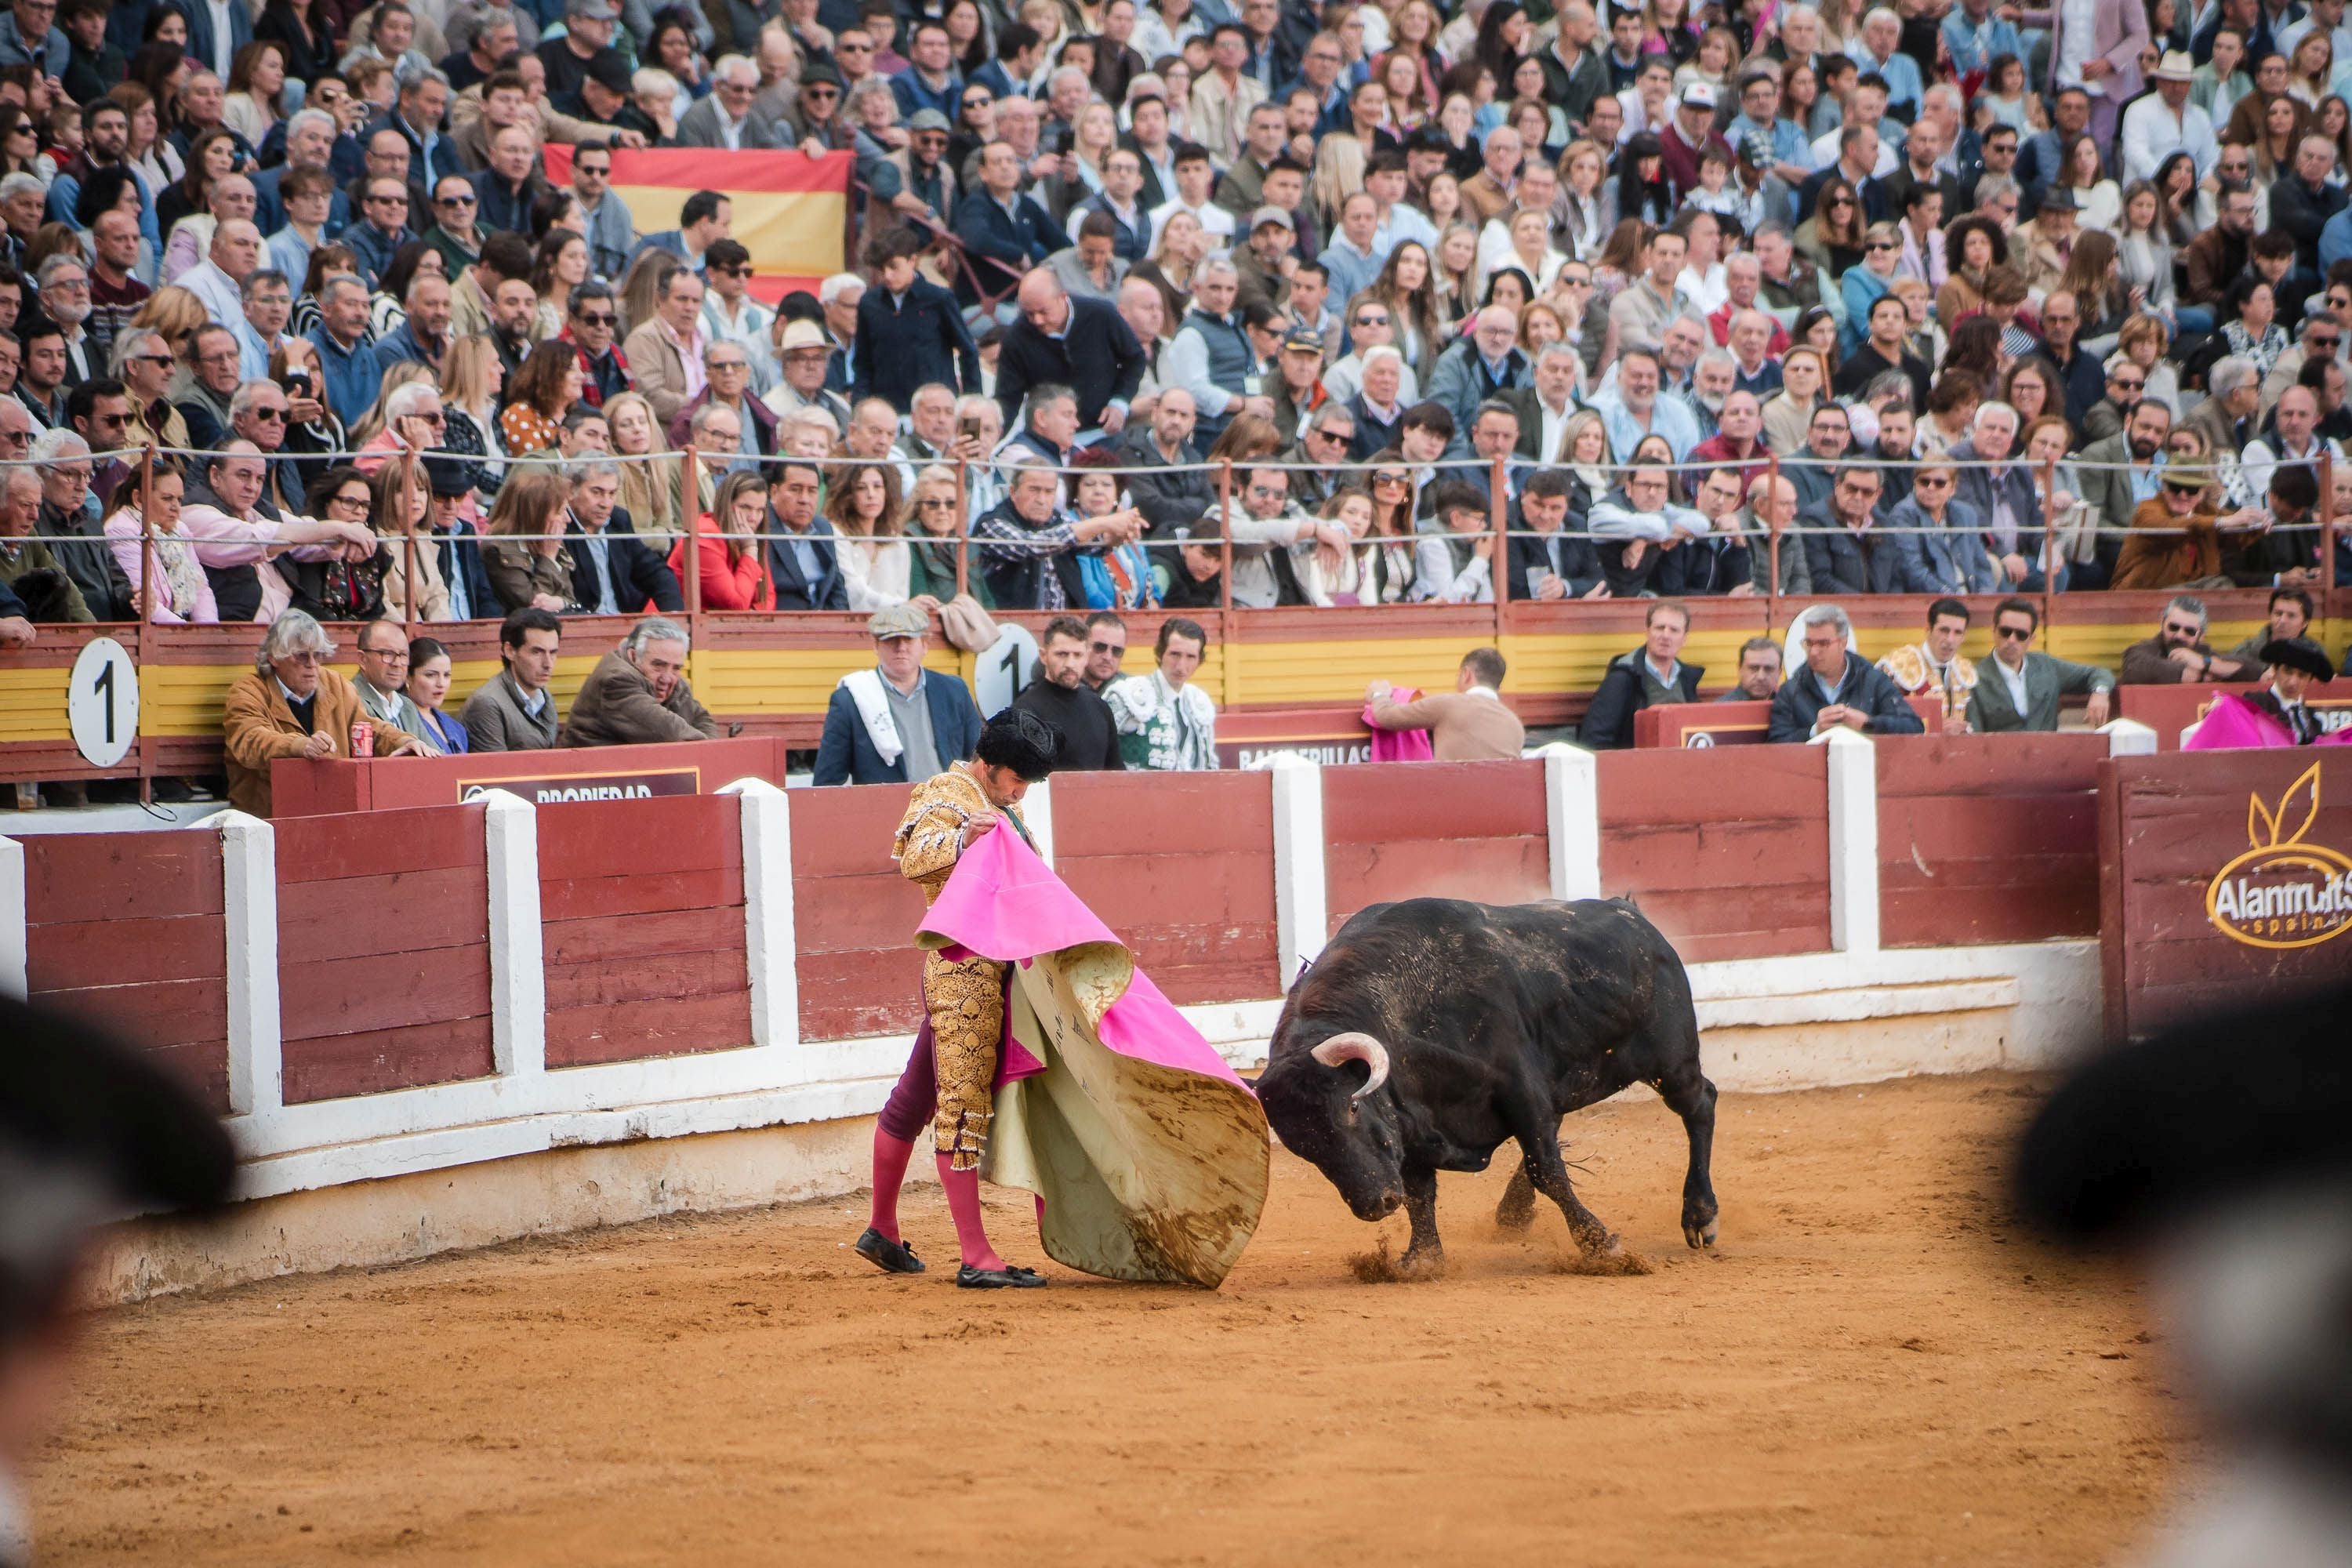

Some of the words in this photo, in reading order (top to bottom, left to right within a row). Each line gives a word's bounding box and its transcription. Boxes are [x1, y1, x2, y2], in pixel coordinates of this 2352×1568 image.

[94, 659, 114, 743] 1
[1000, 643, 1019, 706] 1
[1239, 746, 1371, 771] BAERILLAS
